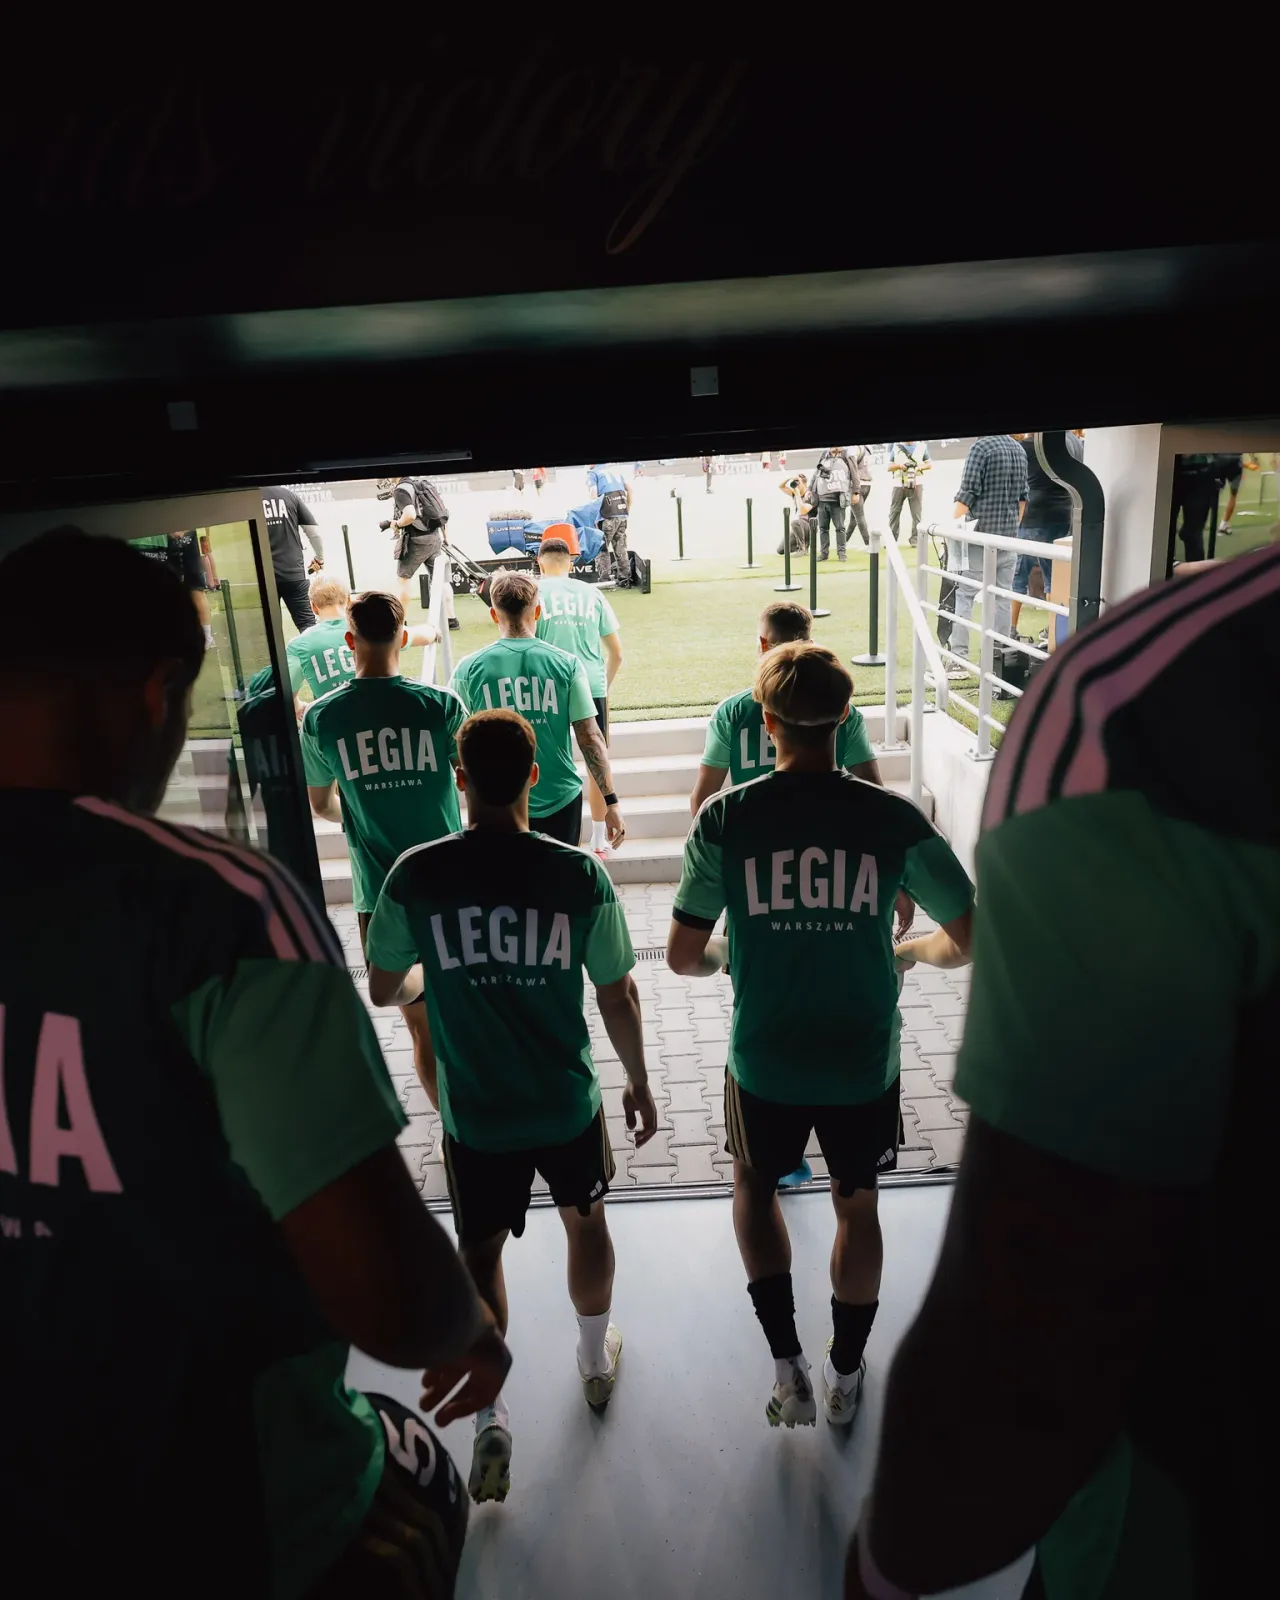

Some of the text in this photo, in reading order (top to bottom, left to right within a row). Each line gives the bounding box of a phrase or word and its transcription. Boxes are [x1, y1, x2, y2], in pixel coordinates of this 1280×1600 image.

[538, 590, 598, 623] LEGIA
[337, 727, 438, 781] LEGIA
[364, 779, 423, 791] WARSZAWA
[744, 846, 879, 916] LEGIA
[430, 905, 571, 971] LEGIA
[770, 921, 854, 932] WARSZAWA
[469, 974, 547, 987] WARZAWA
